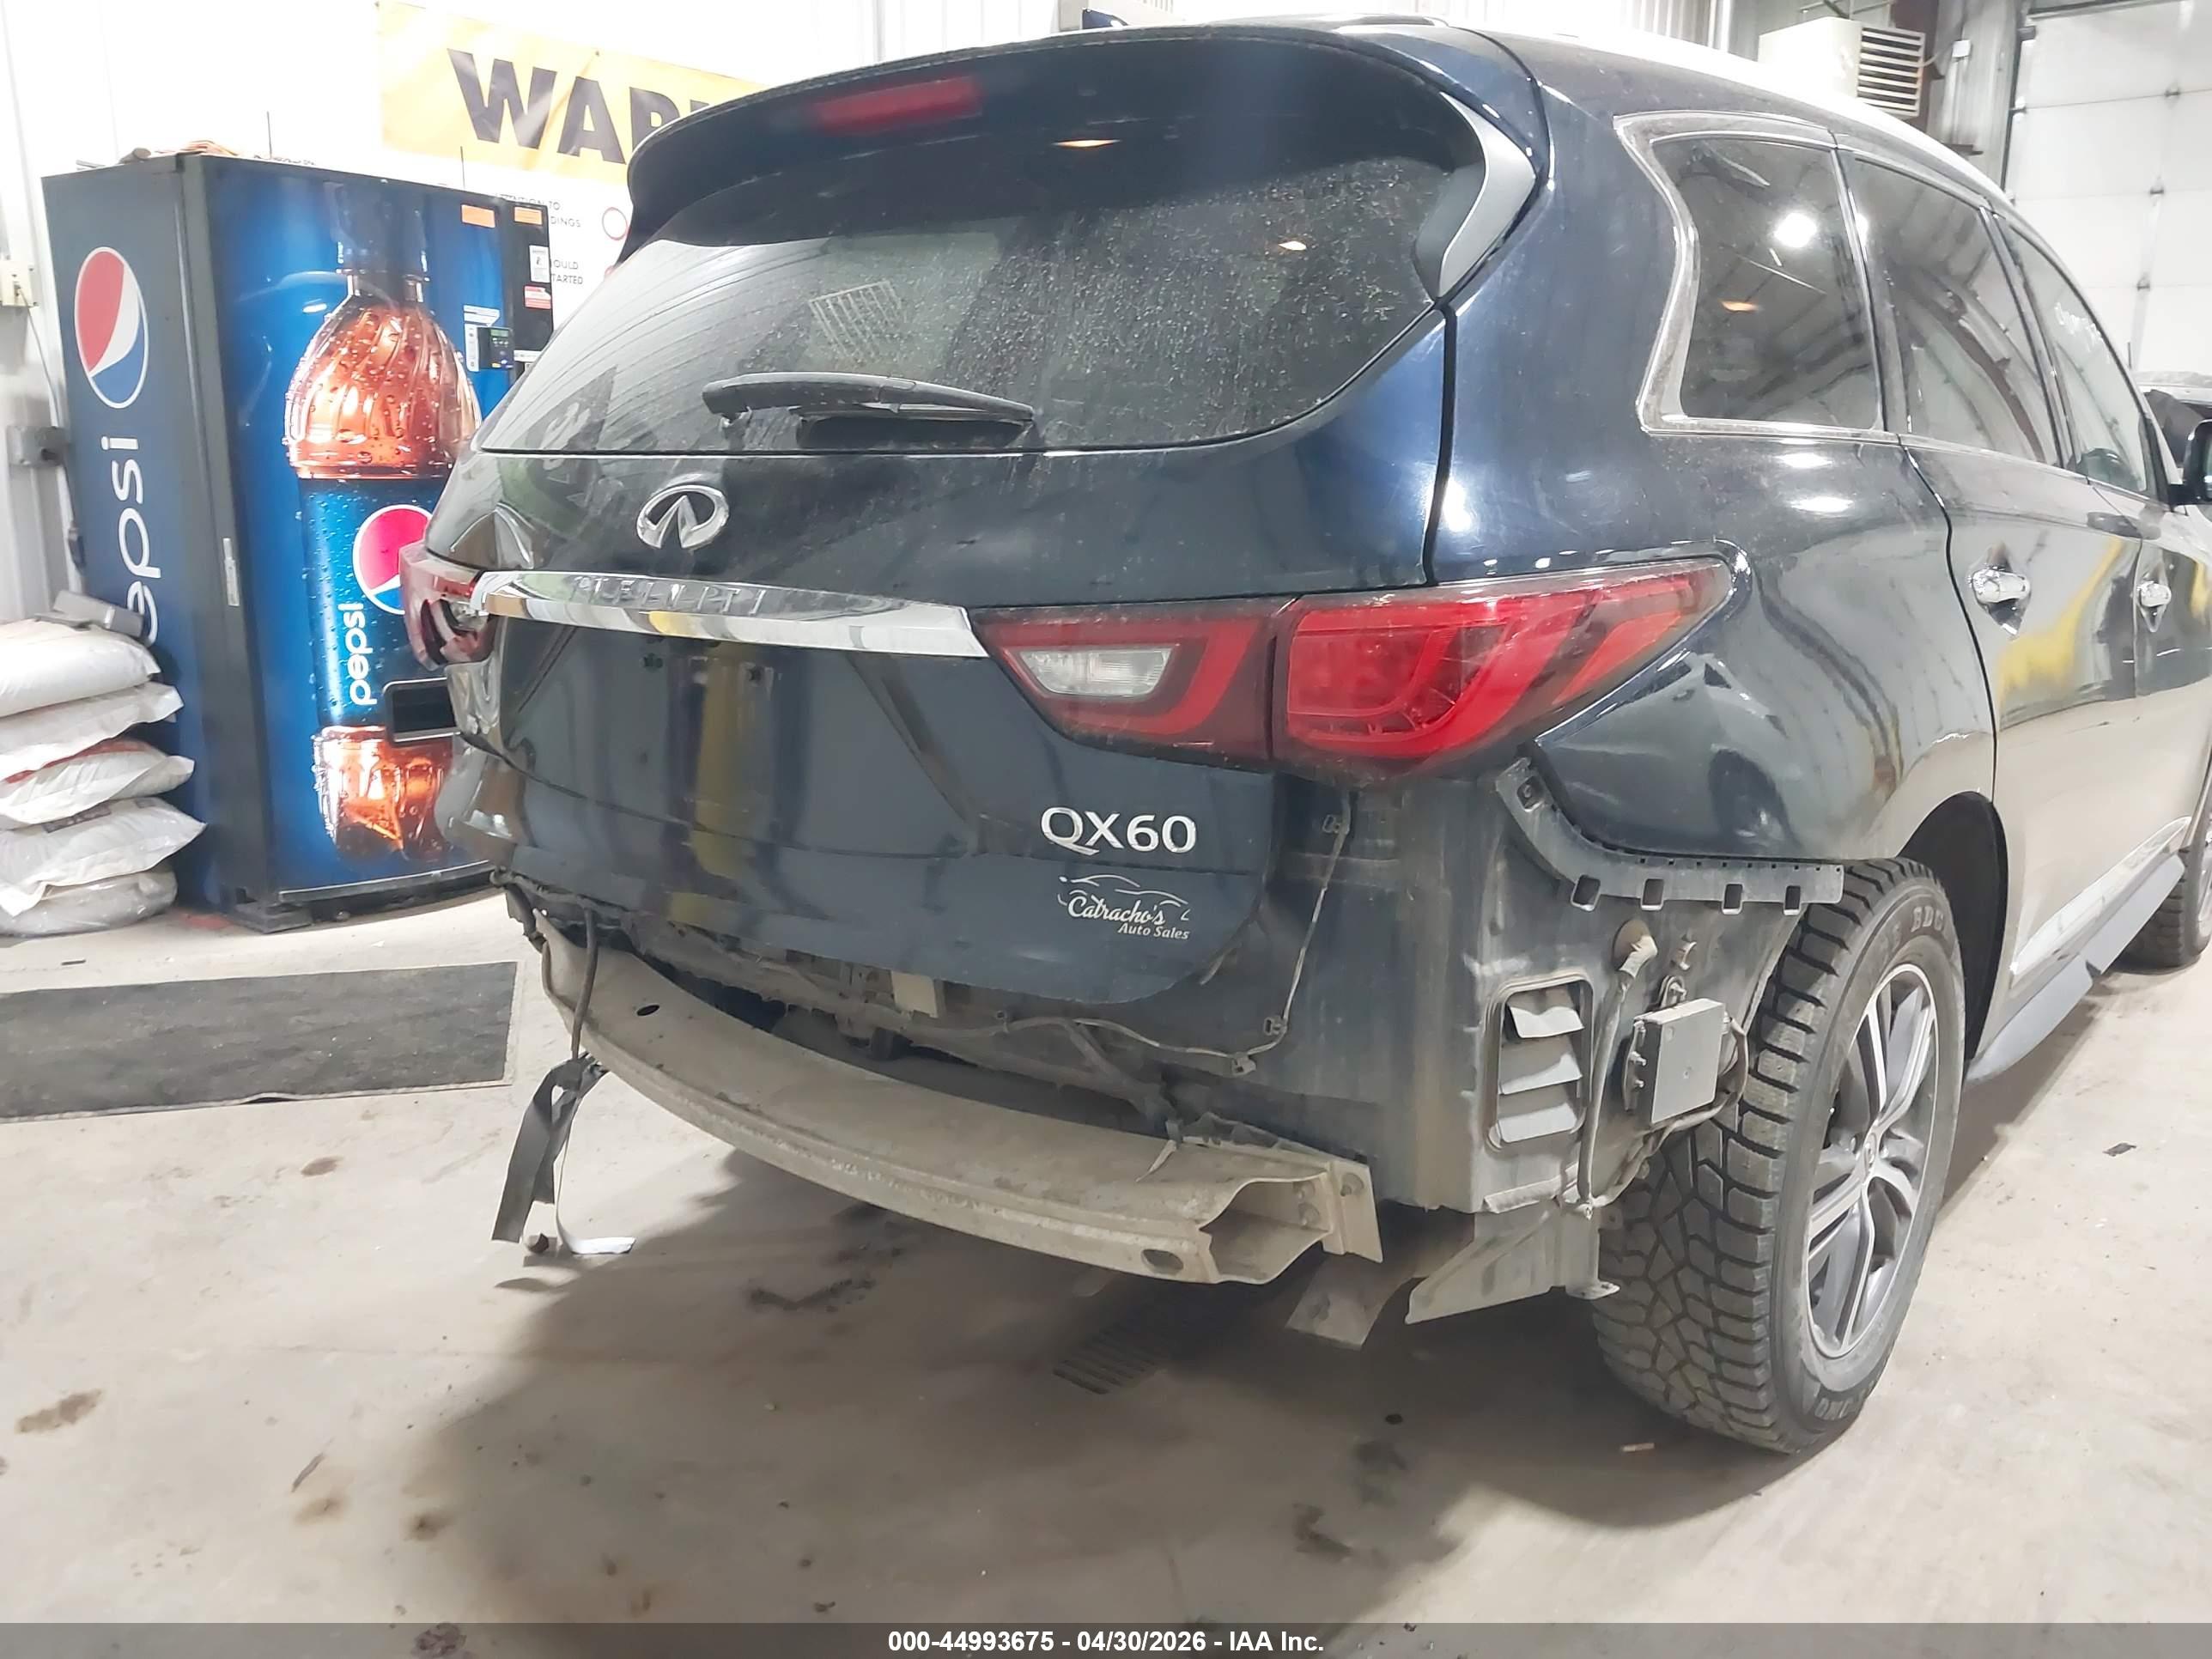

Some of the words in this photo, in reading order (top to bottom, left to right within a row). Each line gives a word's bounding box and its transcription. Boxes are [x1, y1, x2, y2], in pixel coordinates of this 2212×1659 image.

[550, 216, 582, 228] DINGS
[552, 259, 580, 270] OULD
[550, 273, 584, 285] TARTED
[100, 435, 161, 646] epsi
[337, 603, 378, 705] pepsi
[1041, 806, 1197, 856] QX60
[1067, 895, 1166, 926] Catracho's
[1117, 922, 1152, 936] Auto
[1153, 926, 1191, 939] Sales
